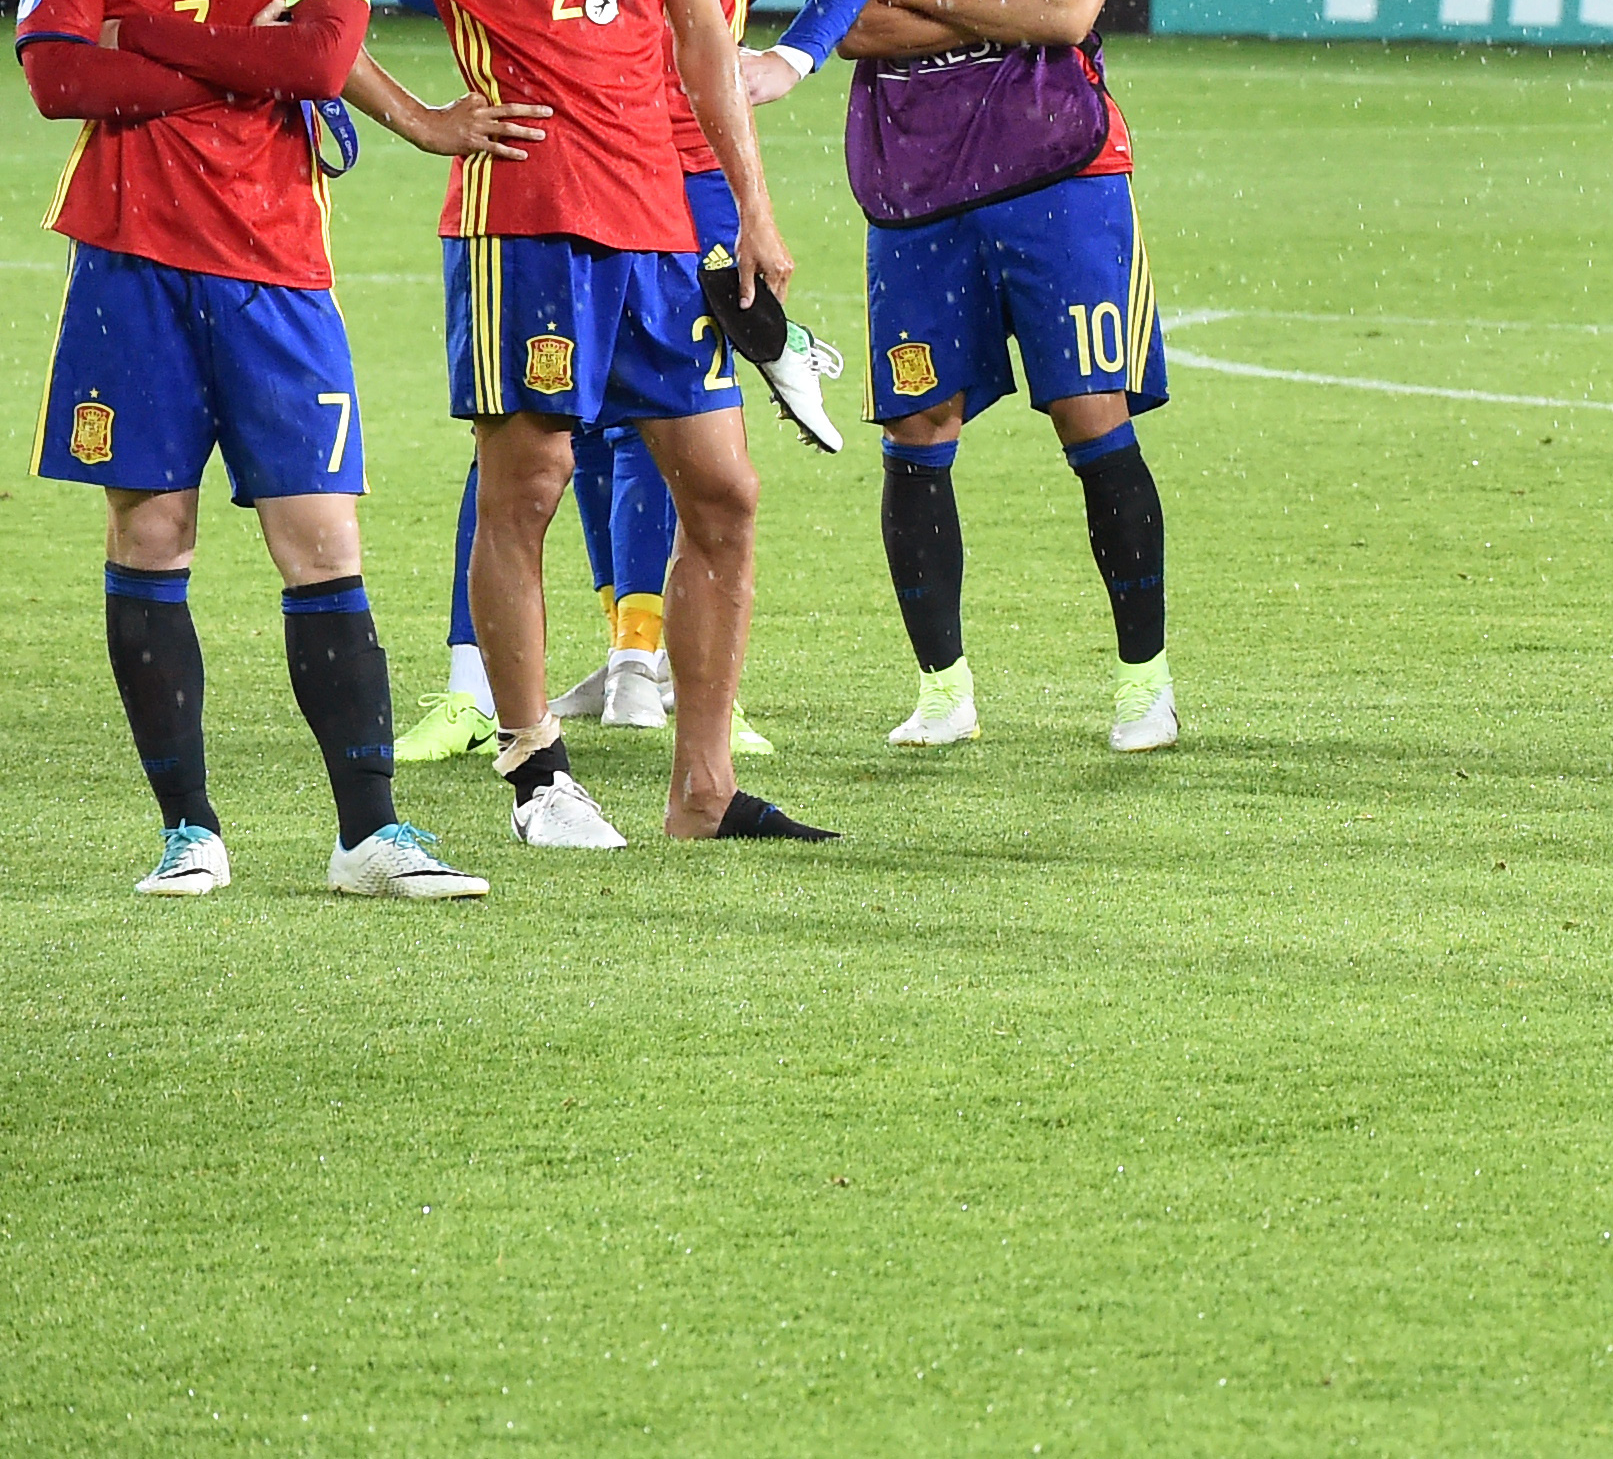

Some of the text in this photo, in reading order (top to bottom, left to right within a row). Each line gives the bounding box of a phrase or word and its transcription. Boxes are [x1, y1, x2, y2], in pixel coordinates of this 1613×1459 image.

[692, 315, 739, 391] 2
[1069, 301, 1125, 376] 10
[318, 392, 351, 473] 7
